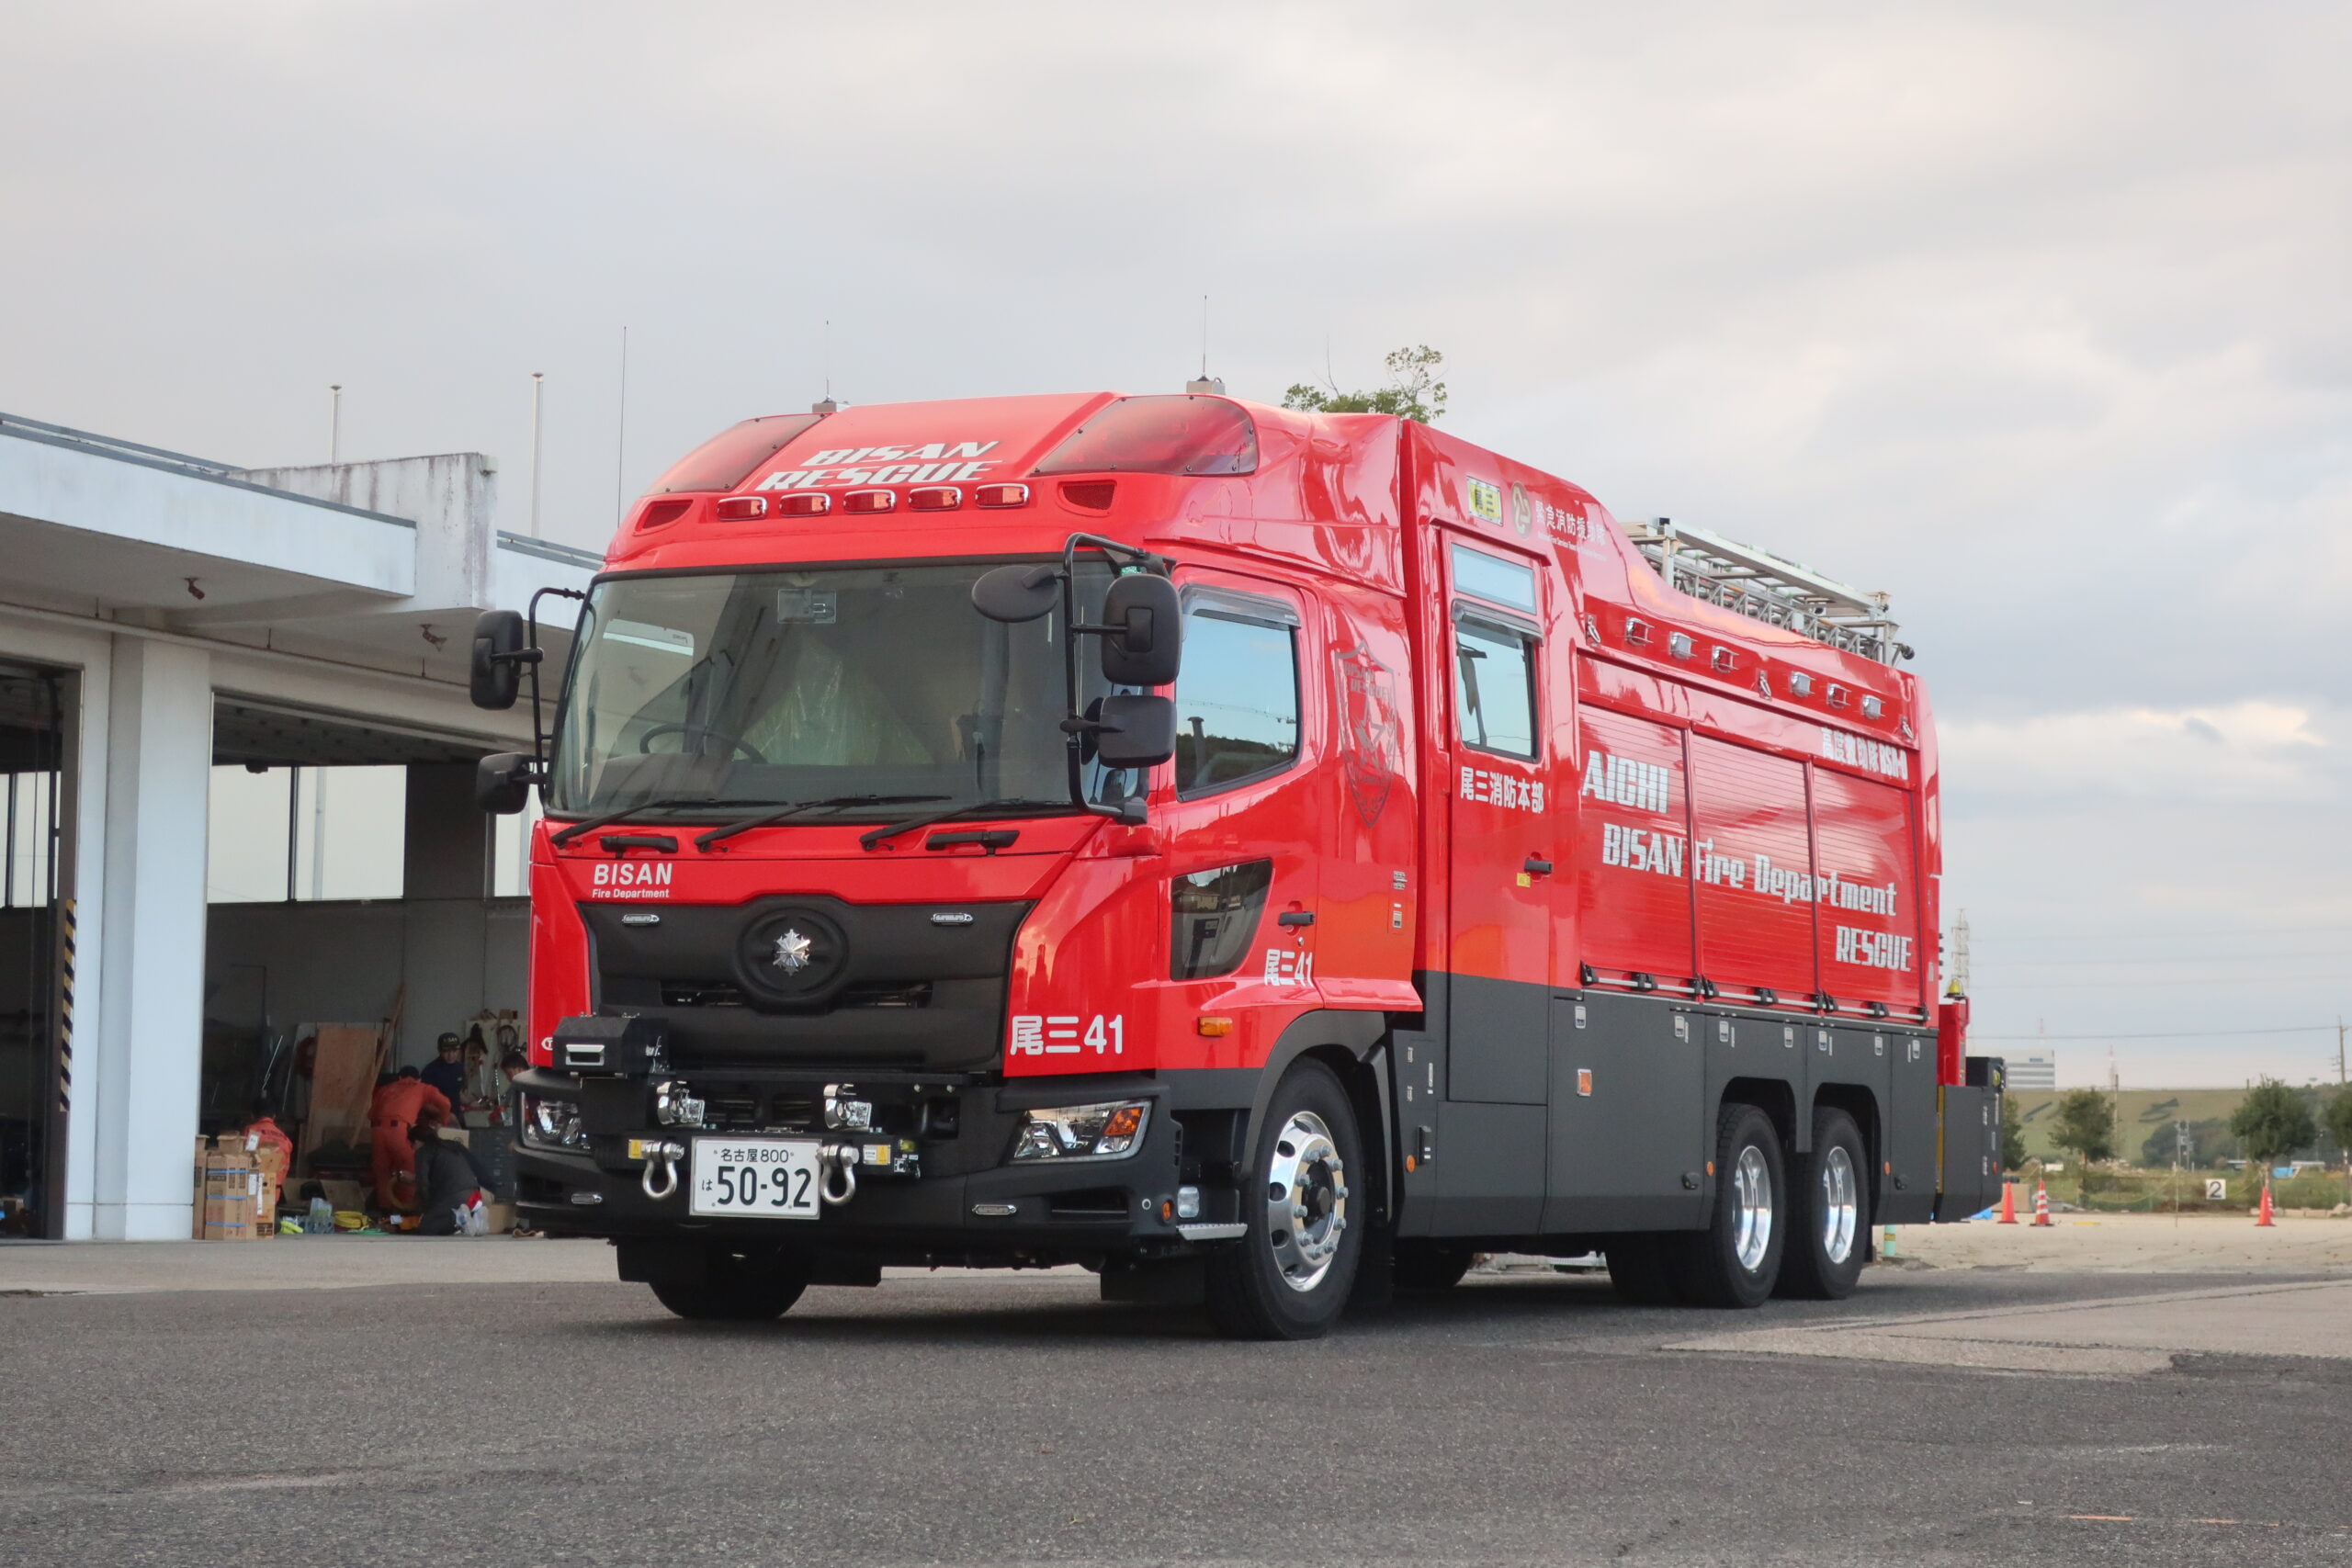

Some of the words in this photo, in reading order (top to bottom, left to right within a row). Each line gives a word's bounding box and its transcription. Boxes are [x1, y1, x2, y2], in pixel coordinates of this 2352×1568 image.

[801, 441, 999, 467] BISAN
[754, 460, 1002, 491] RESCUE
[1460, 766, 1544, 814] 尾三消防本部
[1581, 750, 1668, 814] AICHI
[594, 863, 673, 886] BISAN
[1602, 822, 1684, 877] BISAN
[1695, 838, 1746, 888] Fire
[1754, 853, 1897, 916] Department
[592, 888, 610, 898] Fire
[614, 888, 669, 899] Department
[1264, 949, 1314, 987] 尾三41
[1836, 926, 1913, 972] RESCUE
[1010, 1014, 1123, 1055] 尾三41
[701, 1179, 713, 1191] は
[718, 1166, 811, 1208] 50-92
[2210, 1181, 2222, 1198] 2
